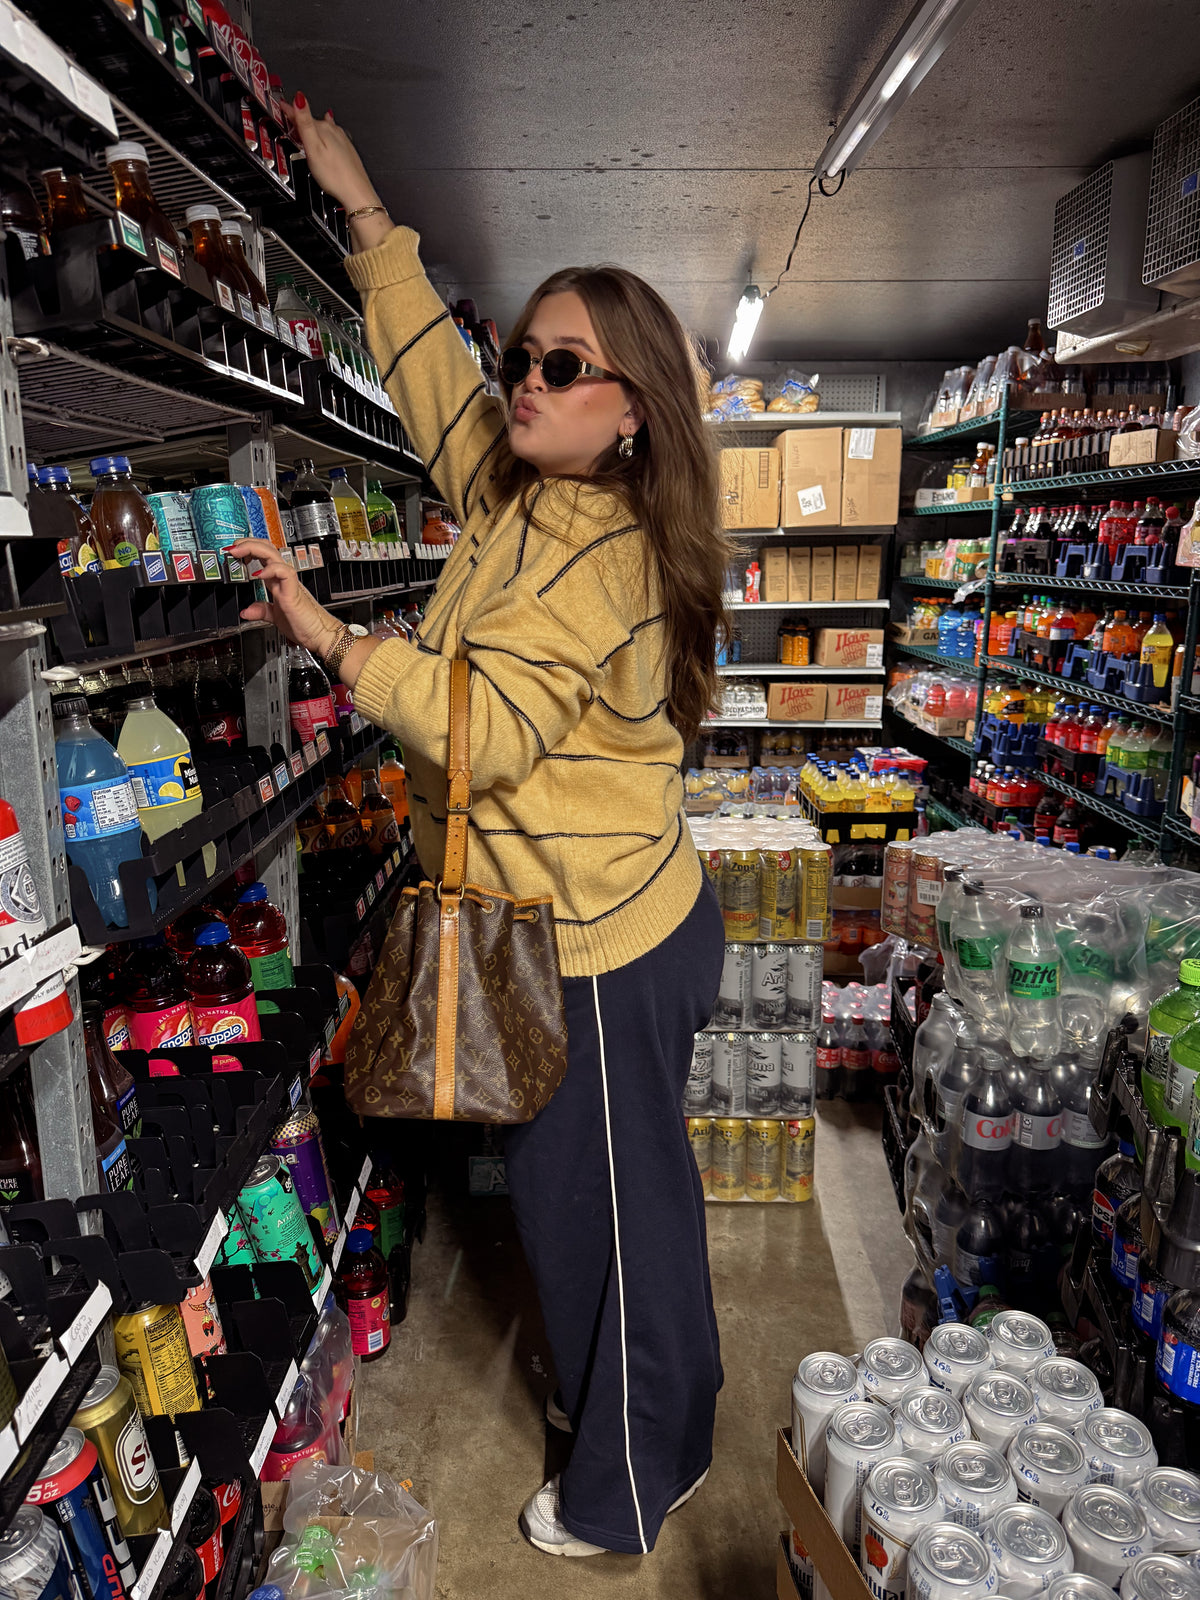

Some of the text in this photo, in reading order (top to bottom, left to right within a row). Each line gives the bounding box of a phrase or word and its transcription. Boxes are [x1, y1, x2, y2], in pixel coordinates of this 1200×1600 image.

[158, 1012, 170, 1024] ALL
[199, 1024, 242, 1046] snapple
[121, 1096, 138, 1119] PURE
[108, 1153, 128, 1182] PURE
[933, 1357, 946, 1371] 16
[863, 1369, 874, 1383] 16
[26, 1379, 43, 1408] Miller
[28, 1399, 44, 1425] Lite
[1088, 1400, 1099, 1411] 16
[949, 1432, 960, 1443] 16
[1019, 1464, 1032, 1479] 16
[870, 1501, 883, 1517] 16
[1121, 1545, 1137, 1558] 16
